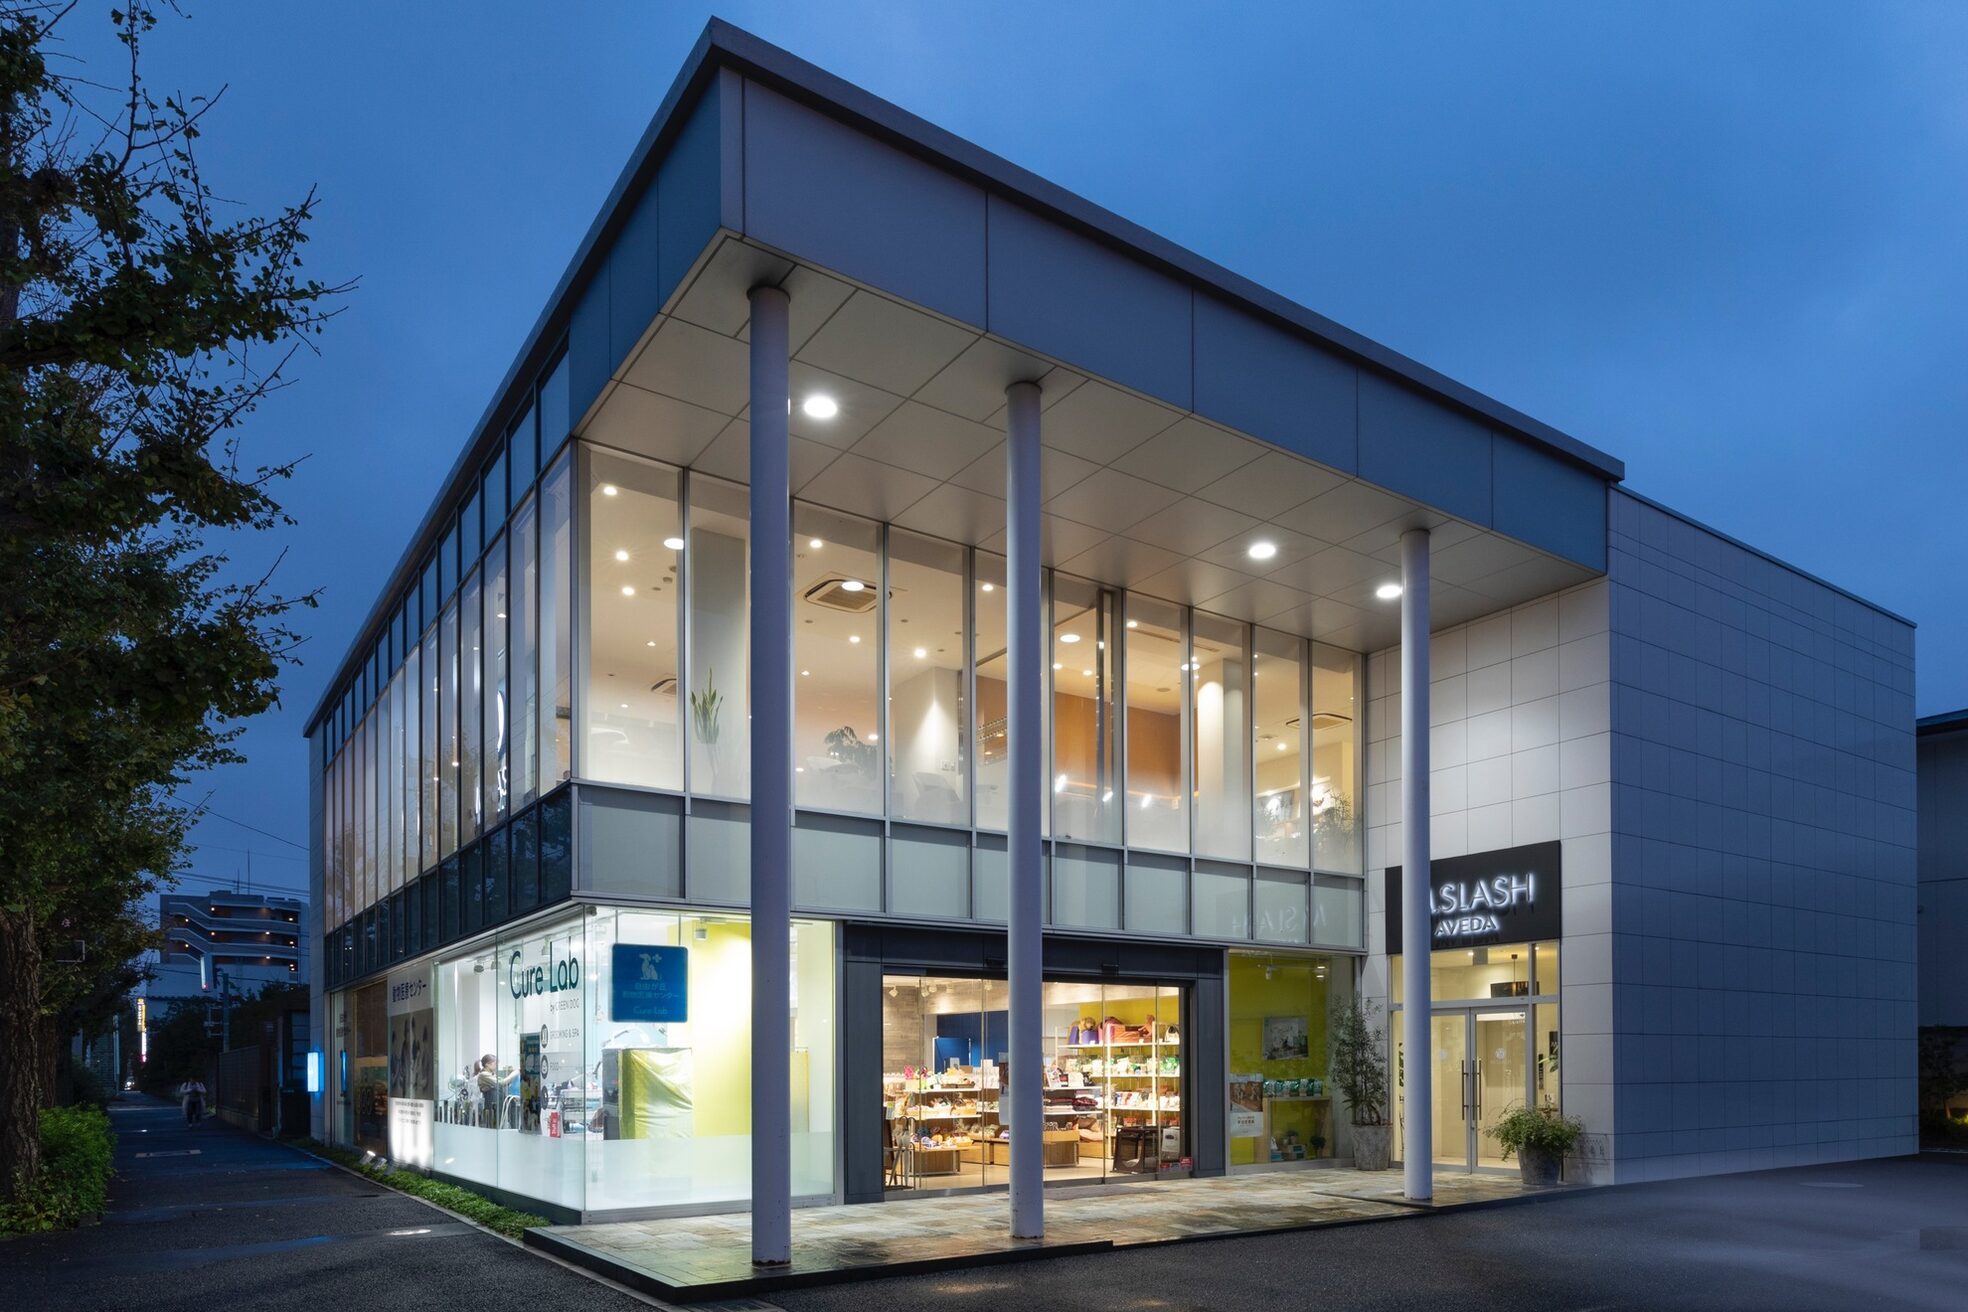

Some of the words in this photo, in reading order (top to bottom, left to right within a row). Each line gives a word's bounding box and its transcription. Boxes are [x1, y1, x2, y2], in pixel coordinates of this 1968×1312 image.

[1434, 916, 1499, 936] AVEDA
[510, 951, 544, 999] Cure
[549, 936, 579, 993] Lab
